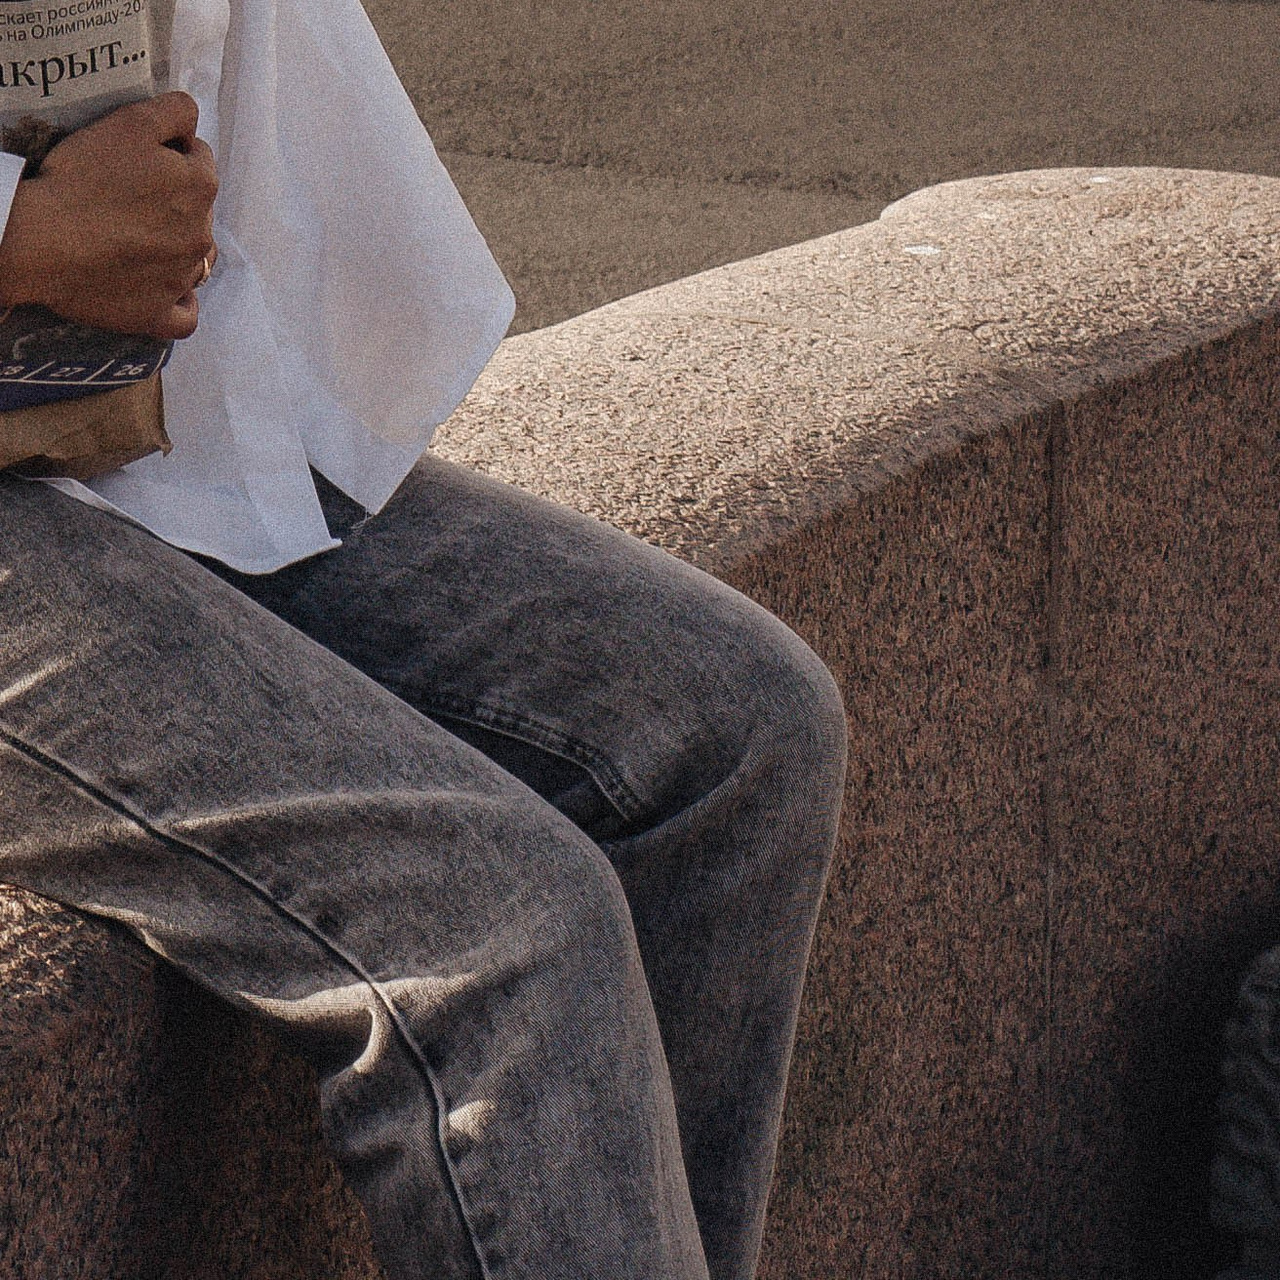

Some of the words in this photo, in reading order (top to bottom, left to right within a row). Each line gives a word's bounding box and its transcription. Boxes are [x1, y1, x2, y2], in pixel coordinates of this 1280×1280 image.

[7, 28, 26, 41] на
[50, 366, 86, 378] 27
[113, 363, 148, 377] 26
